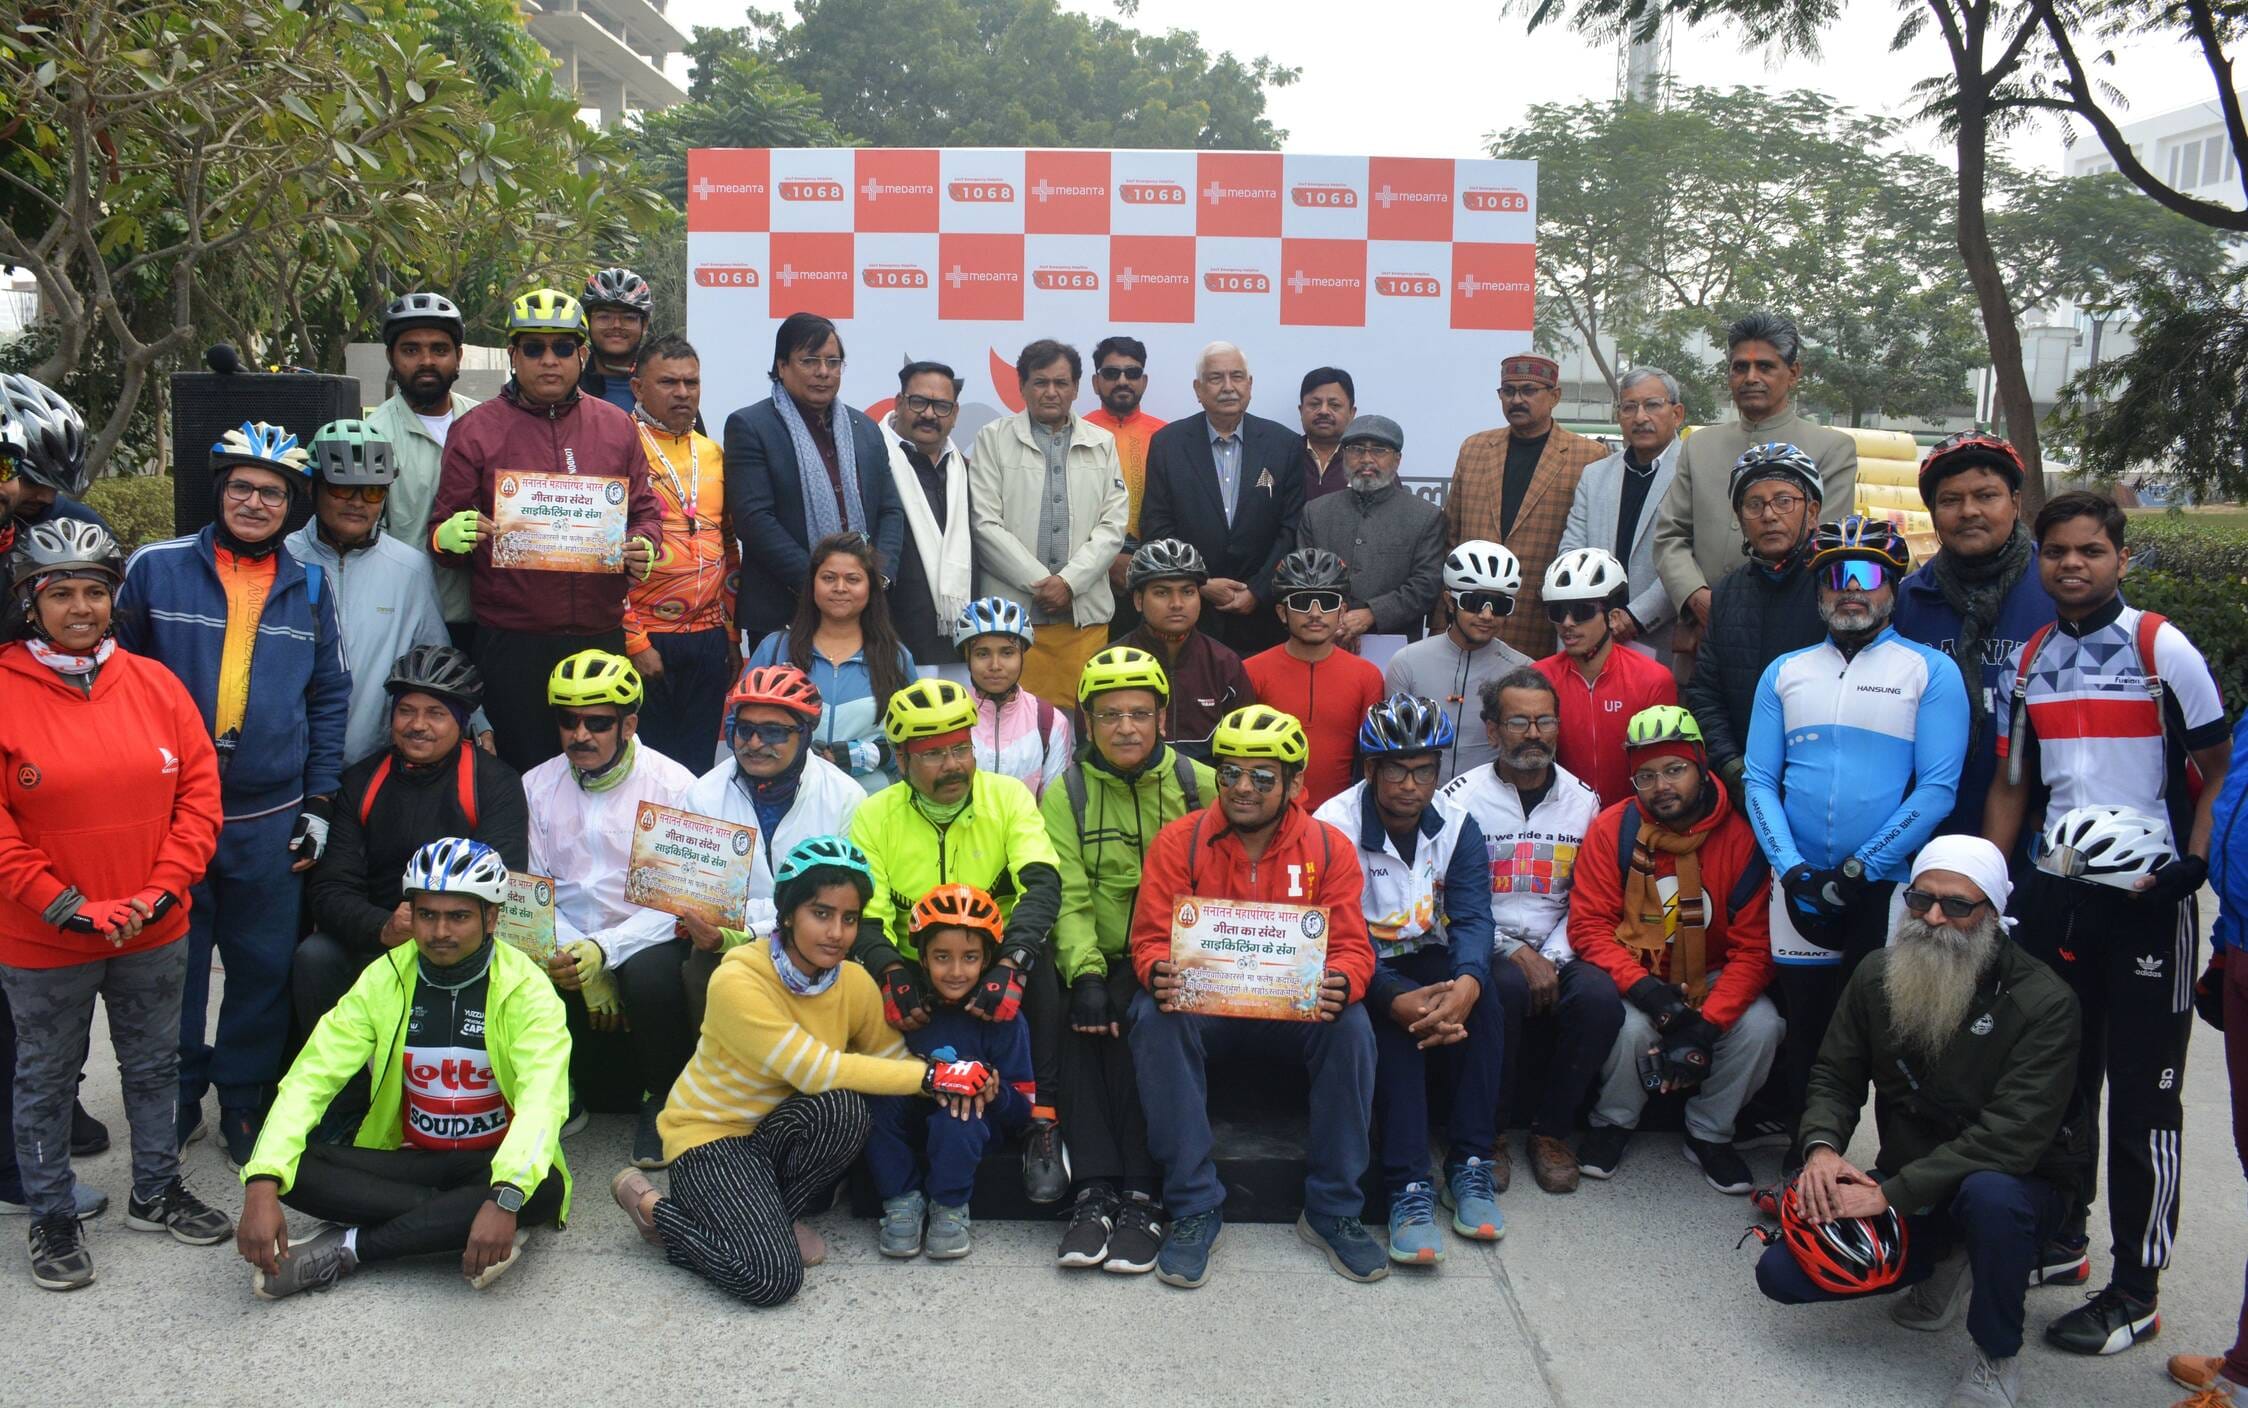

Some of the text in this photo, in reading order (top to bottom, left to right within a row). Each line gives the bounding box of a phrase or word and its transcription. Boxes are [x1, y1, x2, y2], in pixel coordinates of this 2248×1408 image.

[793, 186, 840, 198] 1068
[963, 188, 1010, 199] 1068
[1134, 189, 1182, 200] 1068
[1306, 192, 1354, 204] 1068
[1478, 196, 1524, 208] 1068
[708, 272, 756, 284] 1068
[877, 274, 924, 284] 1068
[1048, 275, 1095, 286] 1068
[1219, 278, 1266, 290] 1068
[1390, 282, 1437, 294] 1068
[531, 491, 592, 505] गीता का संदेश
[573, 508, 583, 518] के
[584, 508, 602, 519] संग
[1857, 685, 1902, 695] HANSUNG
[1604, 700, 1622, 712] UP
[1900, 810, 1920, 830] BIKE
[666, 829, 685, 842] गीता
[686, 836, 698, 845] का
[699, 838, 720, 852] संदेश
[1495, 833, 1514, 842] we
[1518, 831, 1542, 840] ride
[1558, 834, 1584, 844] bike
[700, 853, 710, 864] के
[712, 856, 728, 868] संग
[1213, 922, 1286, 938] गीता का संदेश
[1200, 938, 1296, 956] साइकिलिंग के संग
[2134, 969, 2162, 978] adidas
[410, 1106, 506, 1137] SOUDAL
